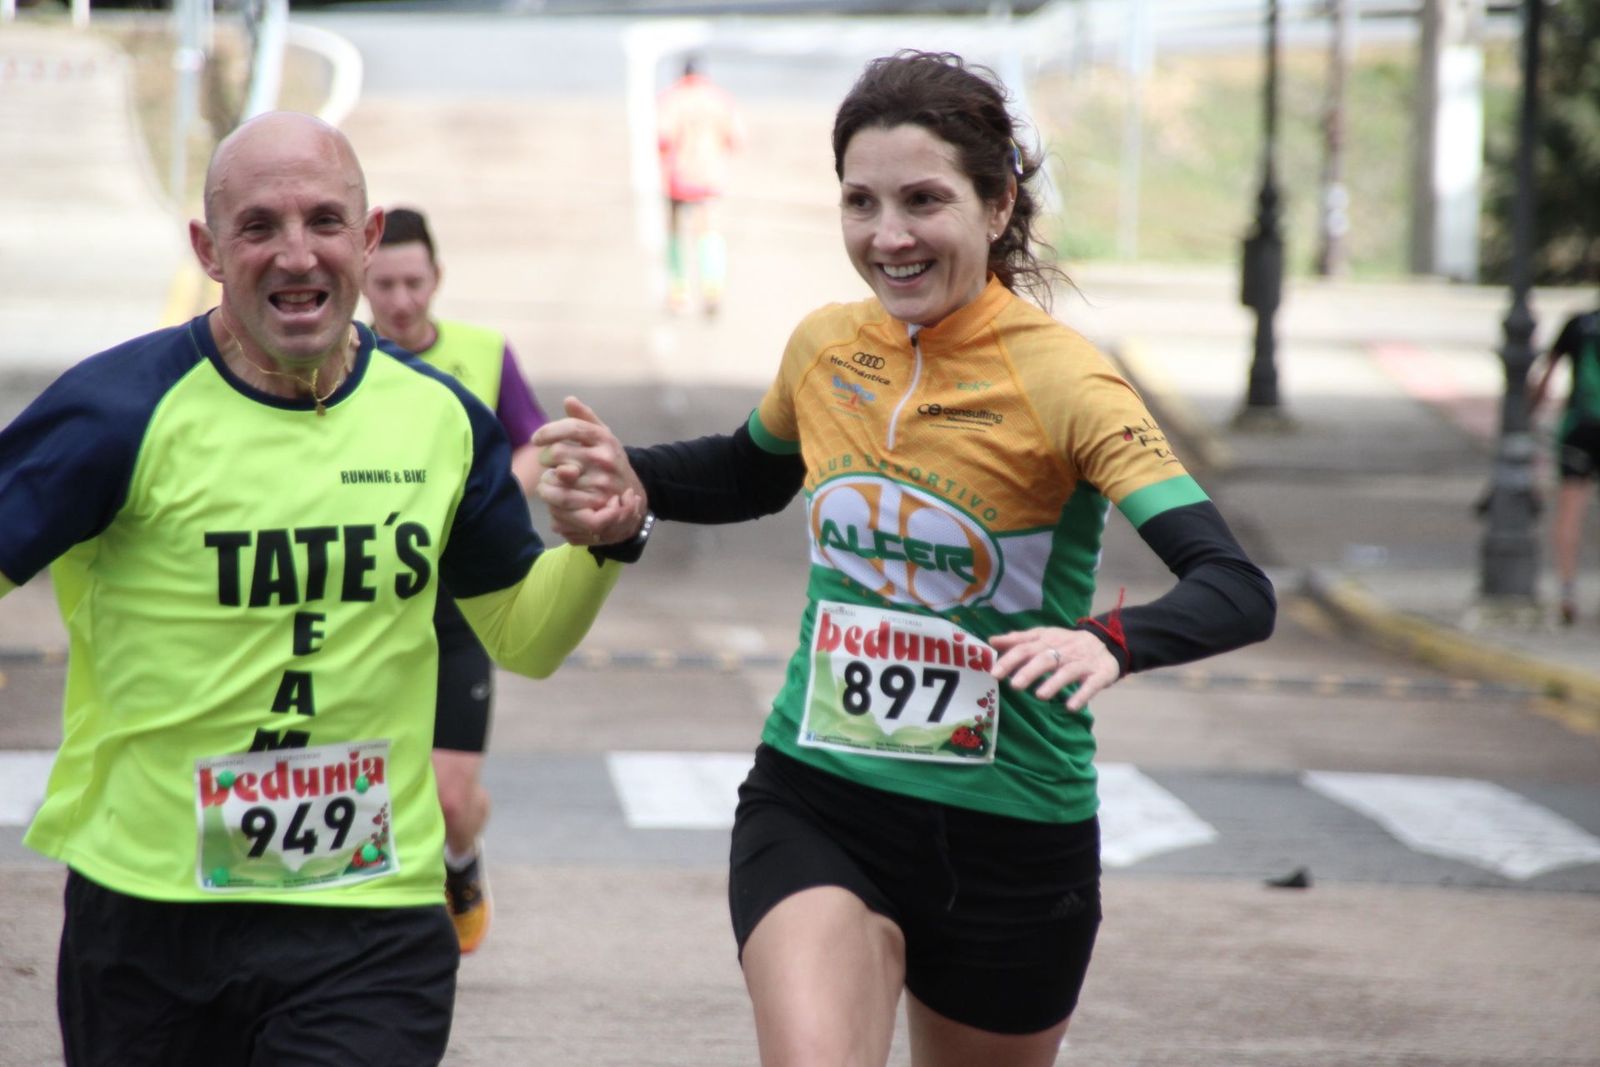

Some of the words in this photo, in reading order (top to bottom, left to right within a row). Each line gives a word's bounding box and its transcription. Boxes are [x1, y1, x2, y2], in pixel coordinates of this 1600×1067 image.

[340, 470, 391, 484] RUNNING
[394, 471, 402, 484] &
[403, 469, 426, 483] BIKE
[819, 519, 976, 584] ALCER
[816, 613, 993, 672] bedunia
[842, 660, 960, 723] 897
[200, 751, 385, 808] bedunia
[241, 796, 357, 859] 949
